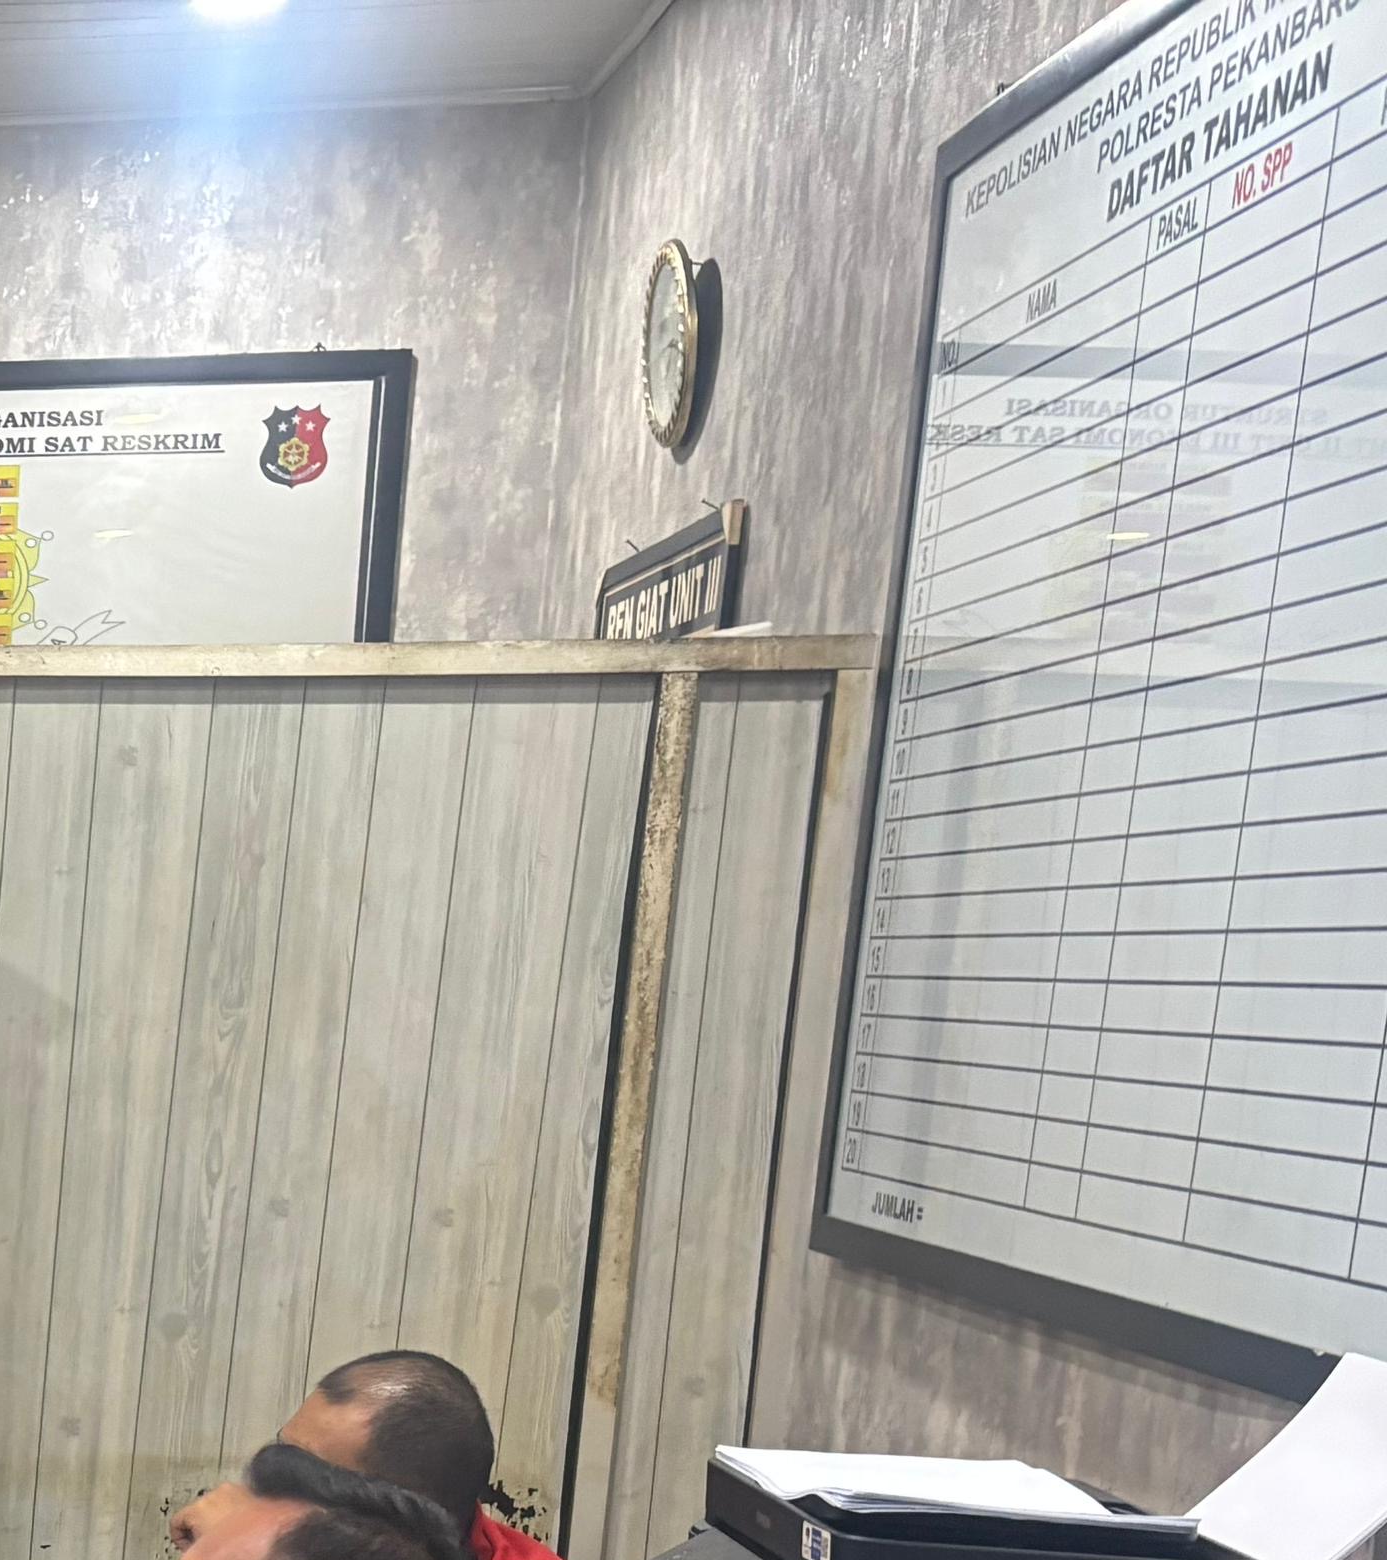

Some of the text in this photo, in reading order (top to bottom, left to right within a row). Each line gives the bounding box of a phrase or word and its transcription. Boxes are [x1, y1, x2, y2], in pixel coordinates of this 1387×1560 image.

[1097, 0, 1361, 174] POLRESTA PEKANBAR
[965, 126, 1061, 218] KEPOLISIAN
[1065, 69, 1143, 152] NEGARA
[1107, 43, 1334, 222] DAFTAR TAHANAN
[1231, 141, 1293, 209] NO. SPP
[1156, 197, 1199, 251] PASAL
[1026, 278, 1057, 324] NAMA
[44, 436, 94, 453] SAT
[102, 433, 223, 451] RESKRIM
[635, 580, 669, 640] GIAT
[669, 563, 705, 629] UNIT
[704, 555, 722, 615] III
[871, 1192, 915, 1223] JUMLAH
